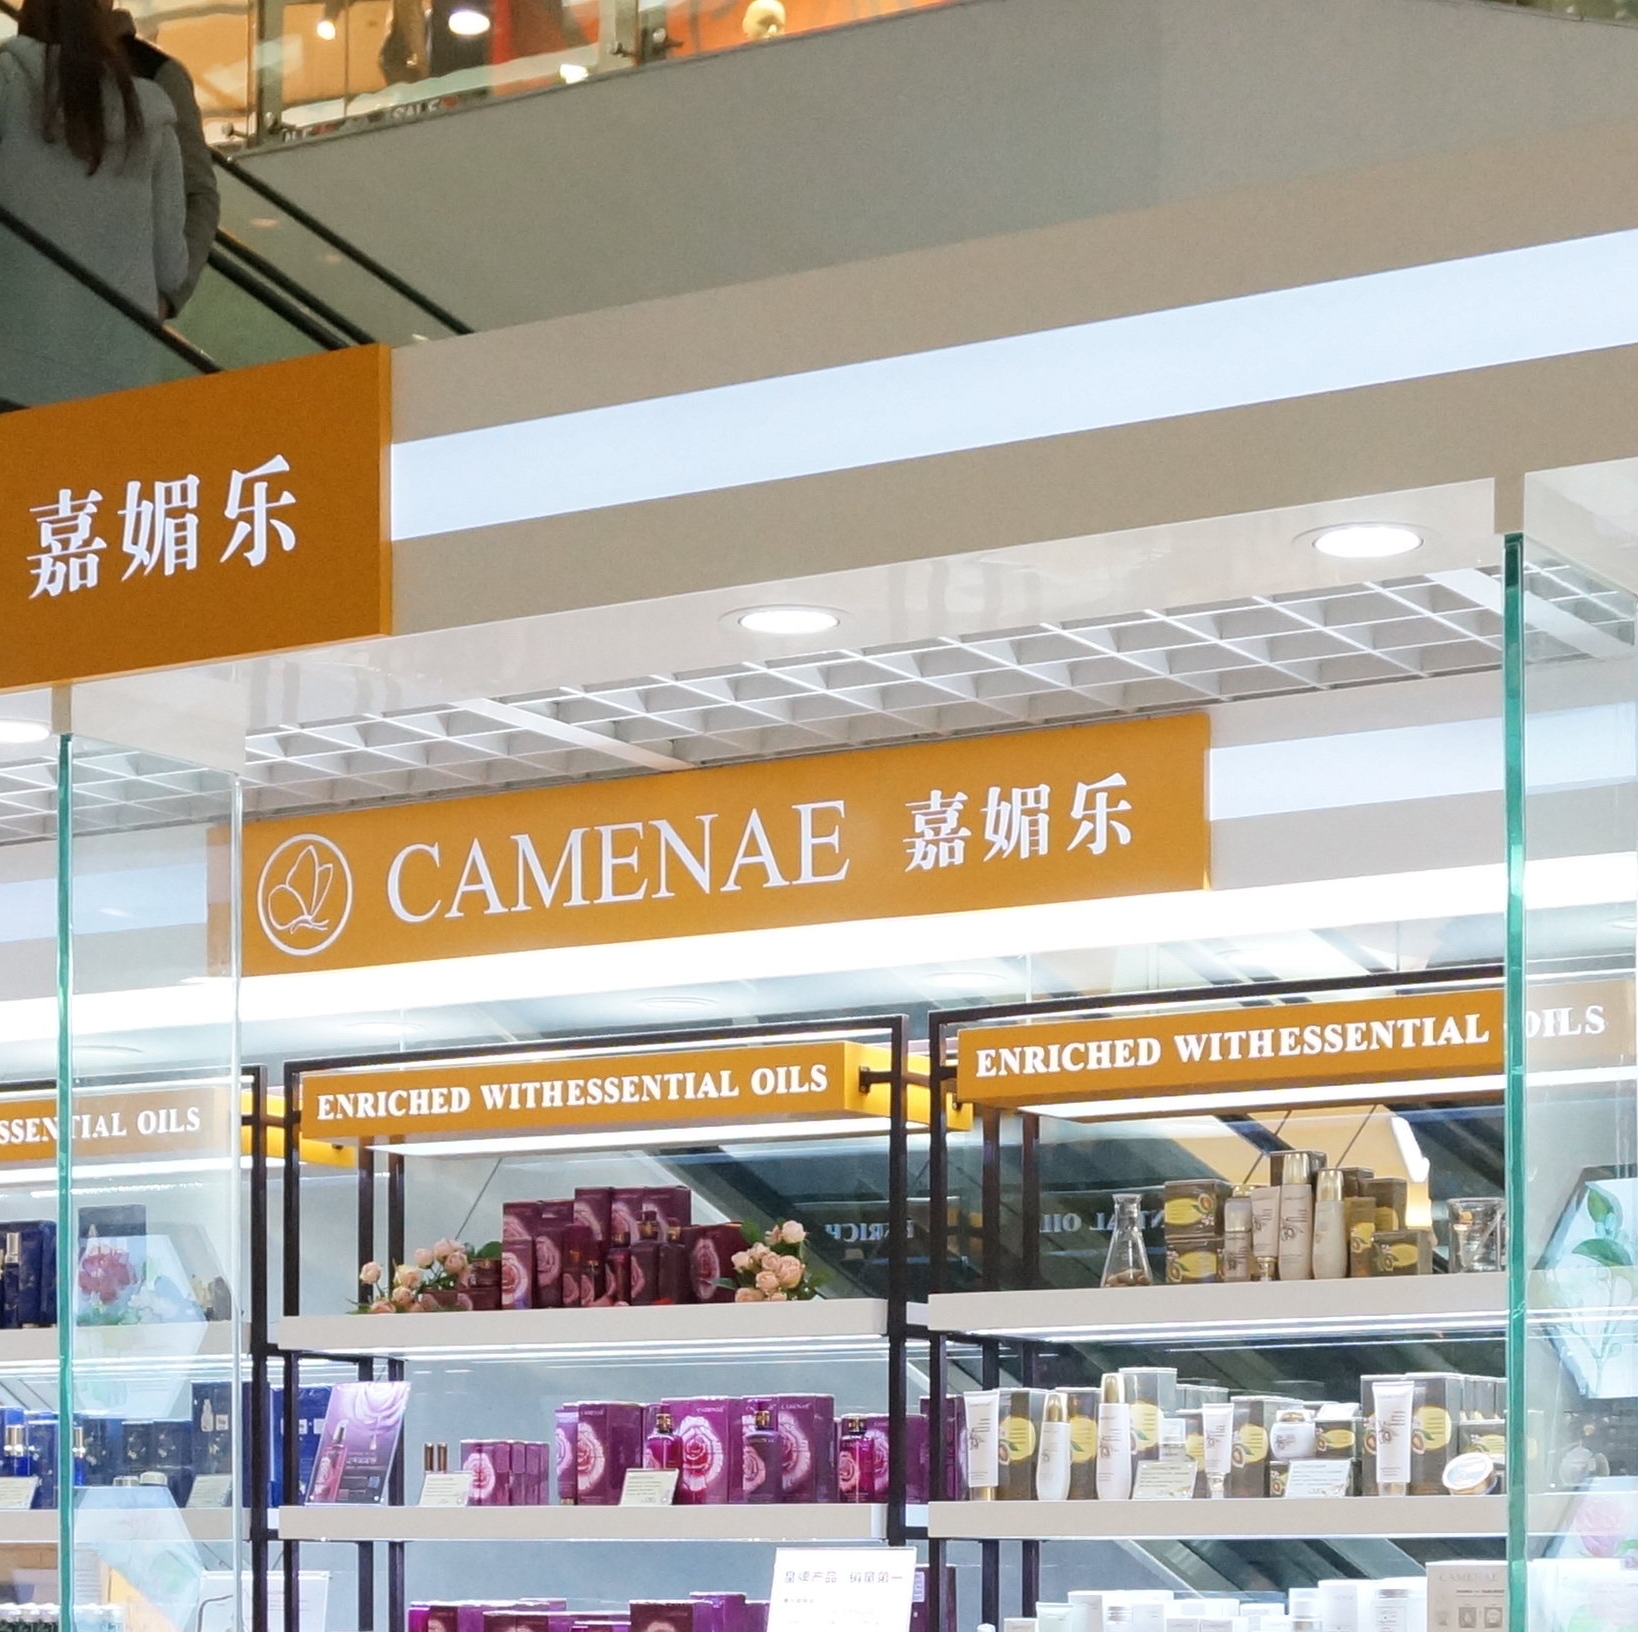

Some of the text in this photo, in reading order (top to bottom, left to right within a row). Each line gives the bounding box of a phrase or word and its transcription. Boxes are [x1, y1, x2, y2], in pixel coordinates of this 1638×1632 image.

[26, 452, 300, 600] 嘉媚乐
[385, 798, 851, 925] CAMENAE
[902, 771, 1135, 873] 嘉媚乐
[974, 1036, 1163, 1079] ENRICHED
[1525, 1004, 1608, 1039] OILS
[136, 1106, 201, 1135] OILS
[315, 1083, 471, 1124] ENRICHED
[750, 1061, 830, 1099] OILS
